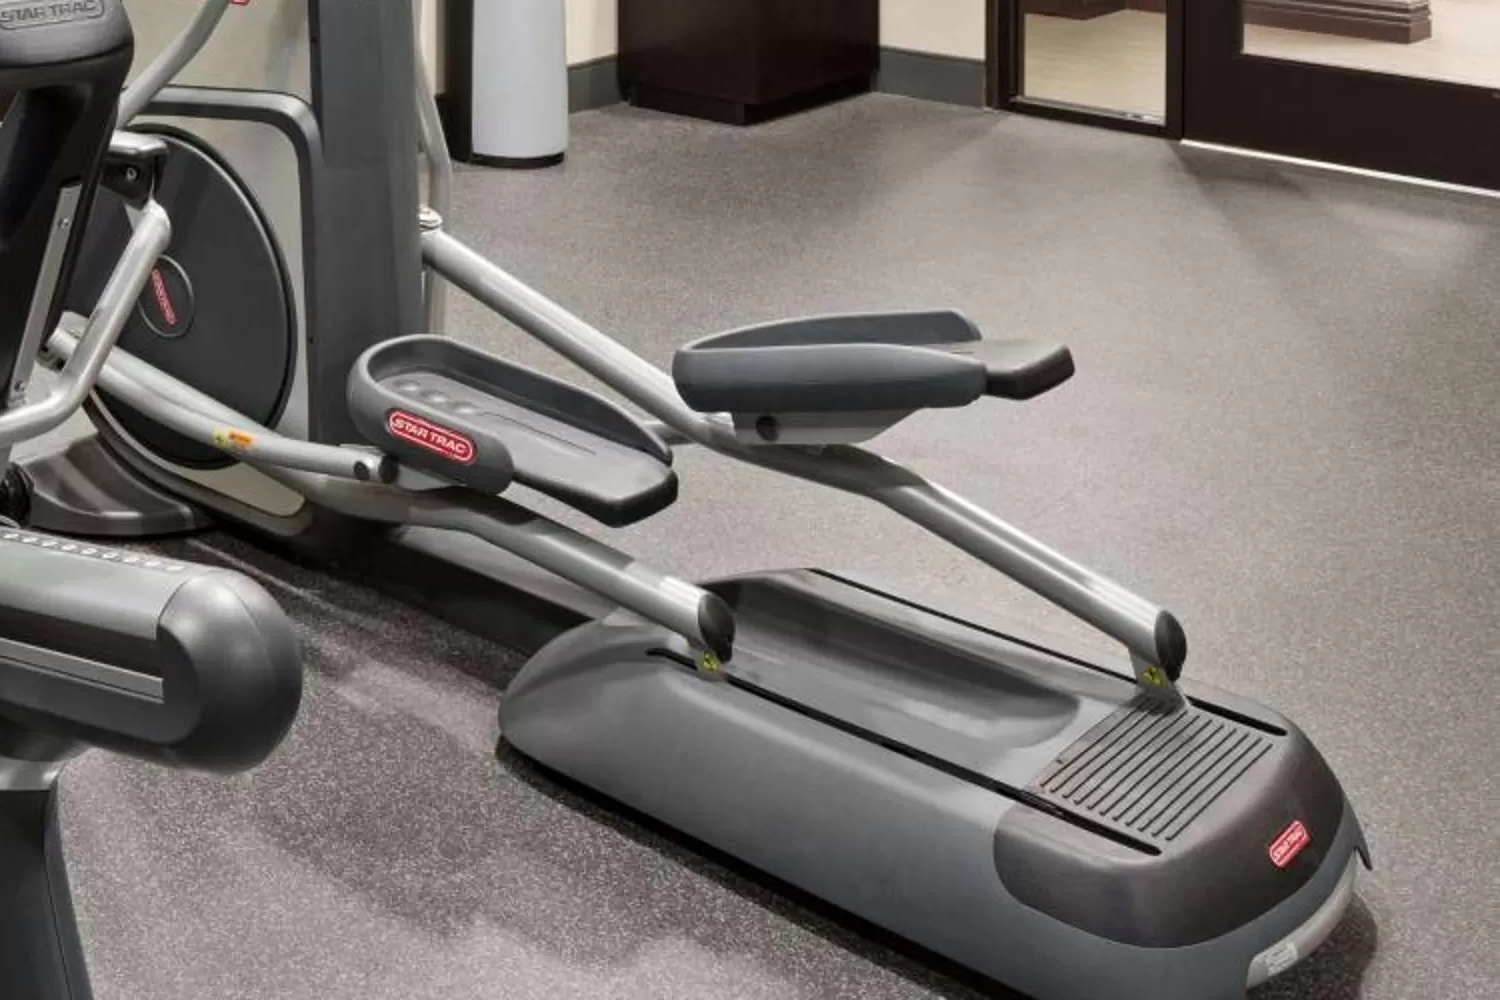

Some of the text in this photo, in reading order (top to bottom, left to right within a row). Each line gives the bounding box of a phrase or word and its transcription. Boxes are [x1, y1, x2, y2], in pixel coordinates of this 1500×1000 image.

[0, 0, 97, 23] STAR TRAC
[393, 418, 468, 455] STAR TRAC
